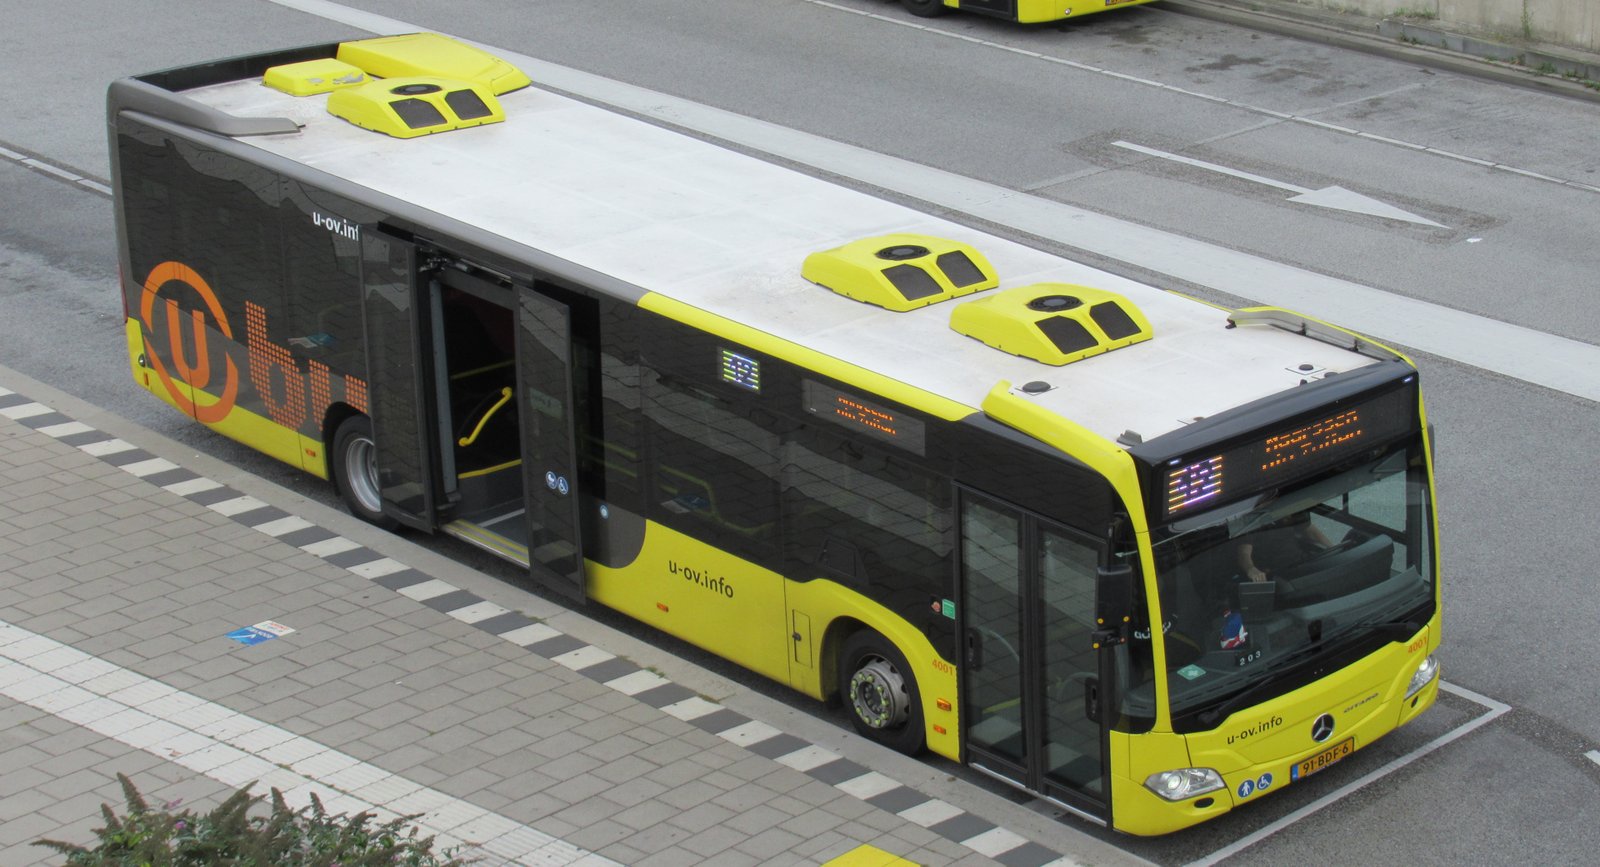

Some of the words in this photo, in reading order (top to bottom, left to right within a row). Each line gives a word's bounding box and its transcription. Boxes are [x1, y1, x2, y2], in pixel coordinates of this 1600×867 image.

[312, 211, 359, 242] u-ov.inf
[668, 560, 734, 598] u-ov.info
[1407, 636, 1428, 654] 4001
[931, 658, 954, 676] 4001
[1226, 715, 1283, 745] u-ov.info
